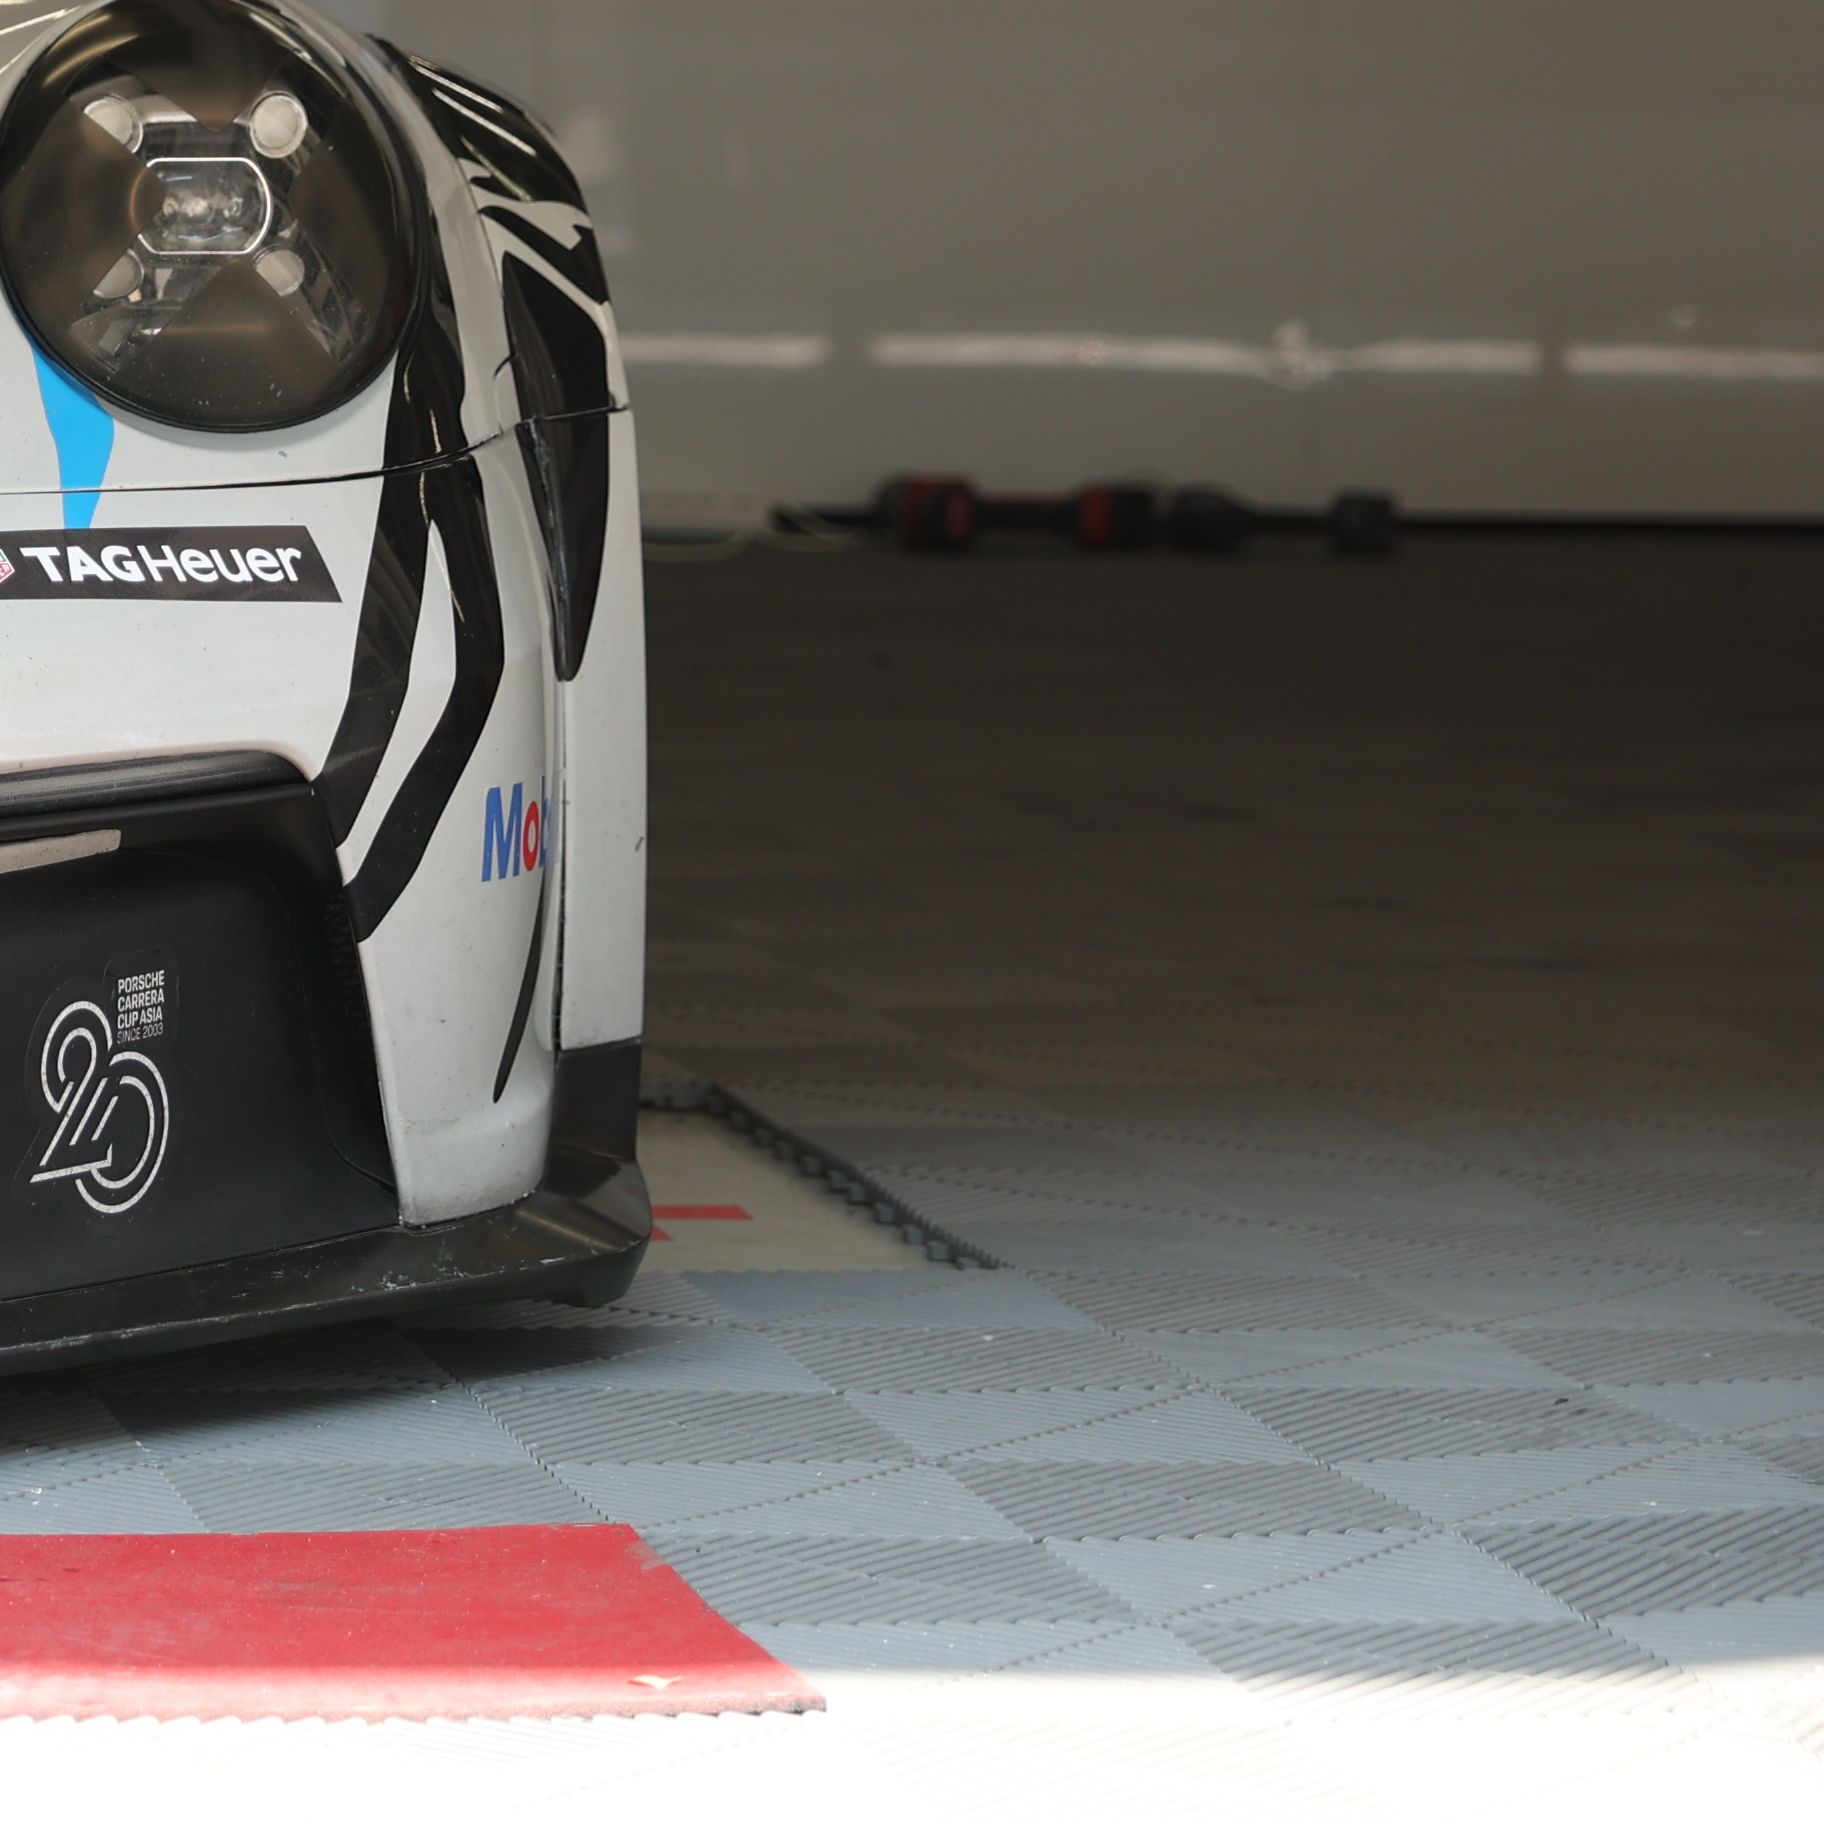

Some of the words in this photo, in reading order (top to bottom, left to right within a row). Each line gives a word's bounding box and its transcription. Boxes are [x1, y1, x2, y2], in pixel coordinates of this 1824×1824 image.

[118, 969, 165, 994] PORSCHE
[117, 988, 165, 1012] CARRERA
[117, 1010, 139, 1030] CUP
[139, 1006, 163, 1025] ASIA
[116, 1028, 141, 1044] SINCE
[142, 1023, 164, 1039] 2003
